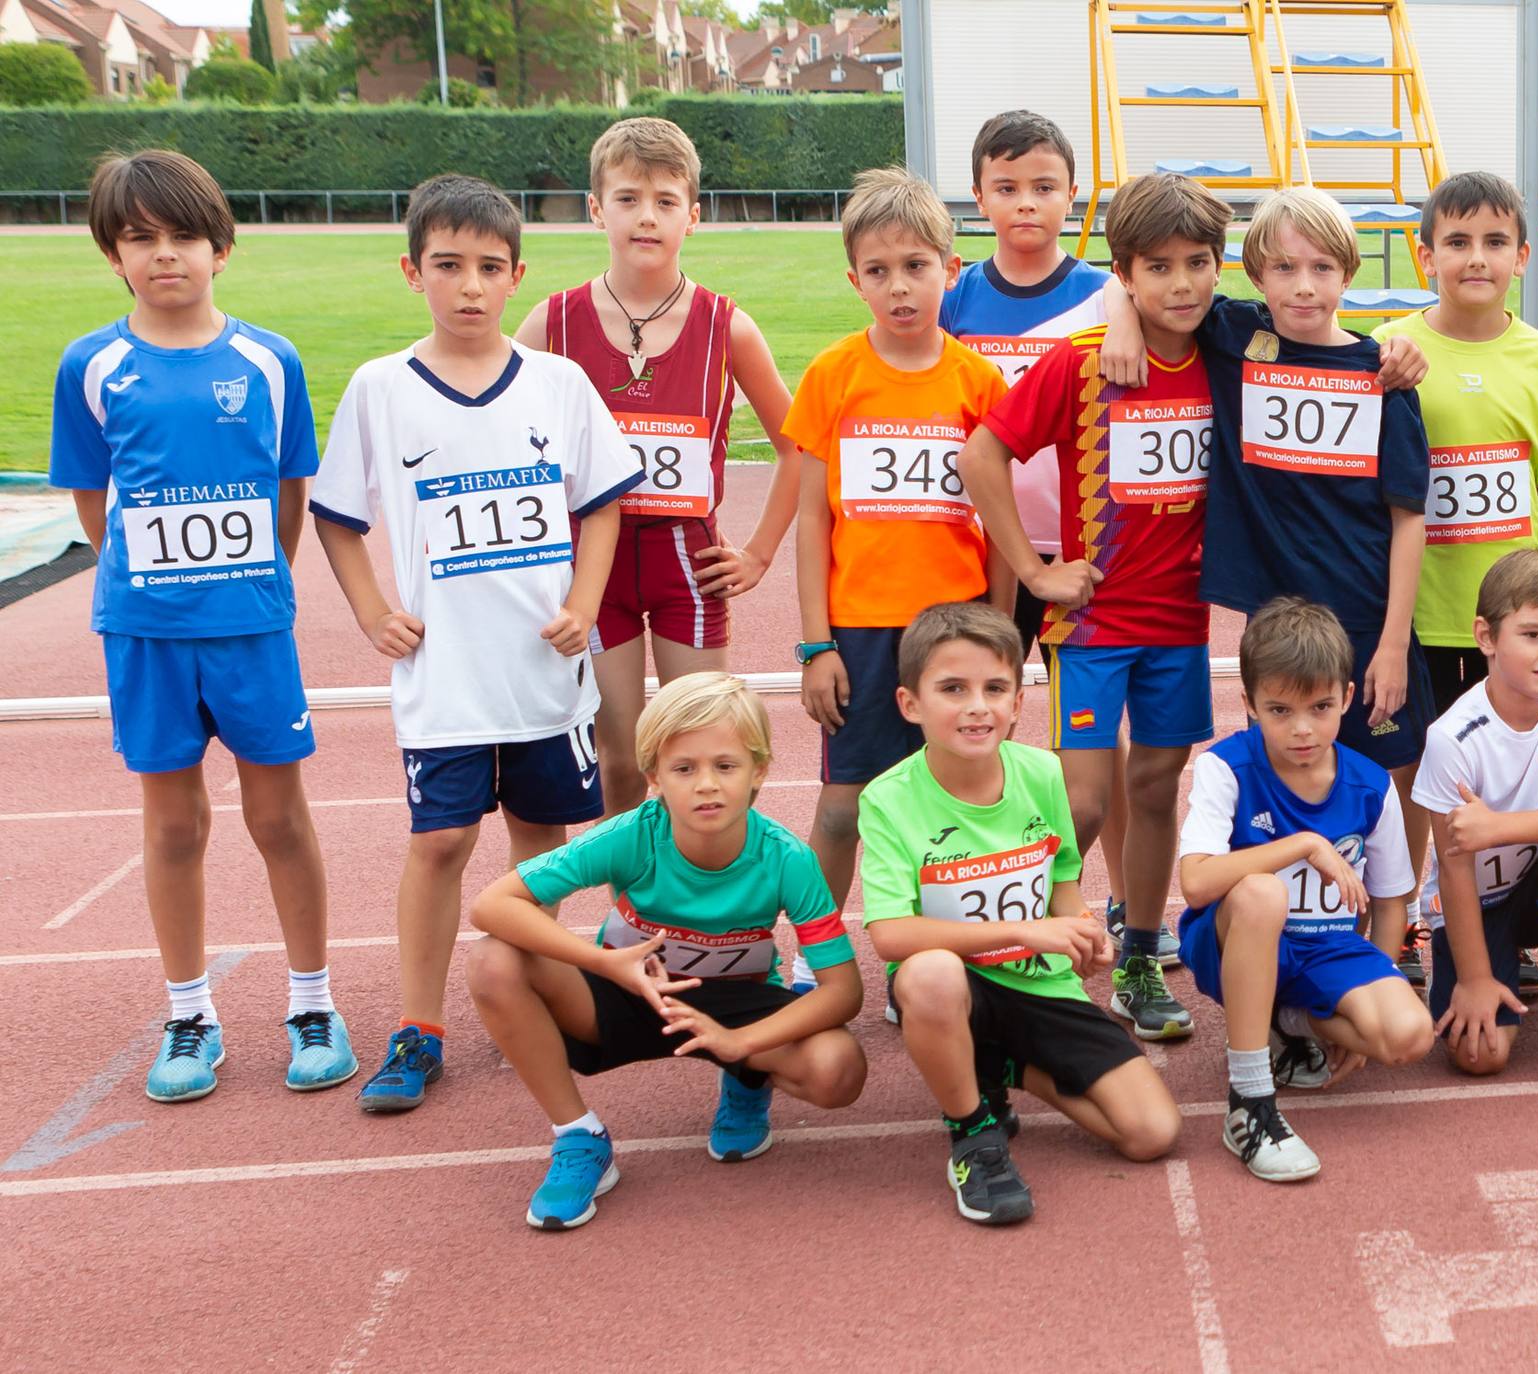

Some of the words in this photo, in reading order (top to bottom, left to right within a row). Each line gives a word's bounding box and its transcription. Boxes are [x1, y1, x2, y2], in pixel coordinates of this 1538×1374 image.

[981, 342, 1014, 353] RIOJA
[1253, 370, 1268, 384] LA
[1270, 372, 1305, 387] RIOJA
[1308, 375, 1372, 392] ATLETISMO
[1125, 408, 1141, 420] LA
[1144, 407, 1176, 419] RIOJA
[1264, 395, 1359, 446] 307
[629, 420, 695, 434] ATLETISMO
[853, 424, 869, 435] LA
[871, 423, 910, 436] RIOJA
[1138, 426, 1214, 476] 308
[1256, 449, 1366, 468] www.lariojaatletismo.com
[1430, 453, 1465, 465] RIOJA
[1467, 447, 1520, 463] ATLETISMO
[460, 467, 553, 492] HEMAFIX
[870, 447, 964, 497] 348
[162, 482, 259, 504] HEMAFIX
[1433, 471, 1518, 519] 338
[445, 496, 548, 551] 113
[146, 511, 253, 564] 109
[446, 560, 478, 572] Central
[479, 555, 524, 568] Logroñesa
[525, 552, 538, 562] de
[539, 549, 572, 561] Pinturas
[147, 574, 180, 586] Central
[181, 571, 229, 585] Logroñesa
[230, 569, 243, 579] de
[244, 566, 276, 577] Pinturas
[936, 869, 953, 882] LA
[957, 863, 997, 879] RIOJA
[960, 873, 1045, 922] 368
[623, 910, 637, 927] LA
[687, 933, 761, 945] ATLETISMO
[1329, 923, 1353, 932] Pinturas
